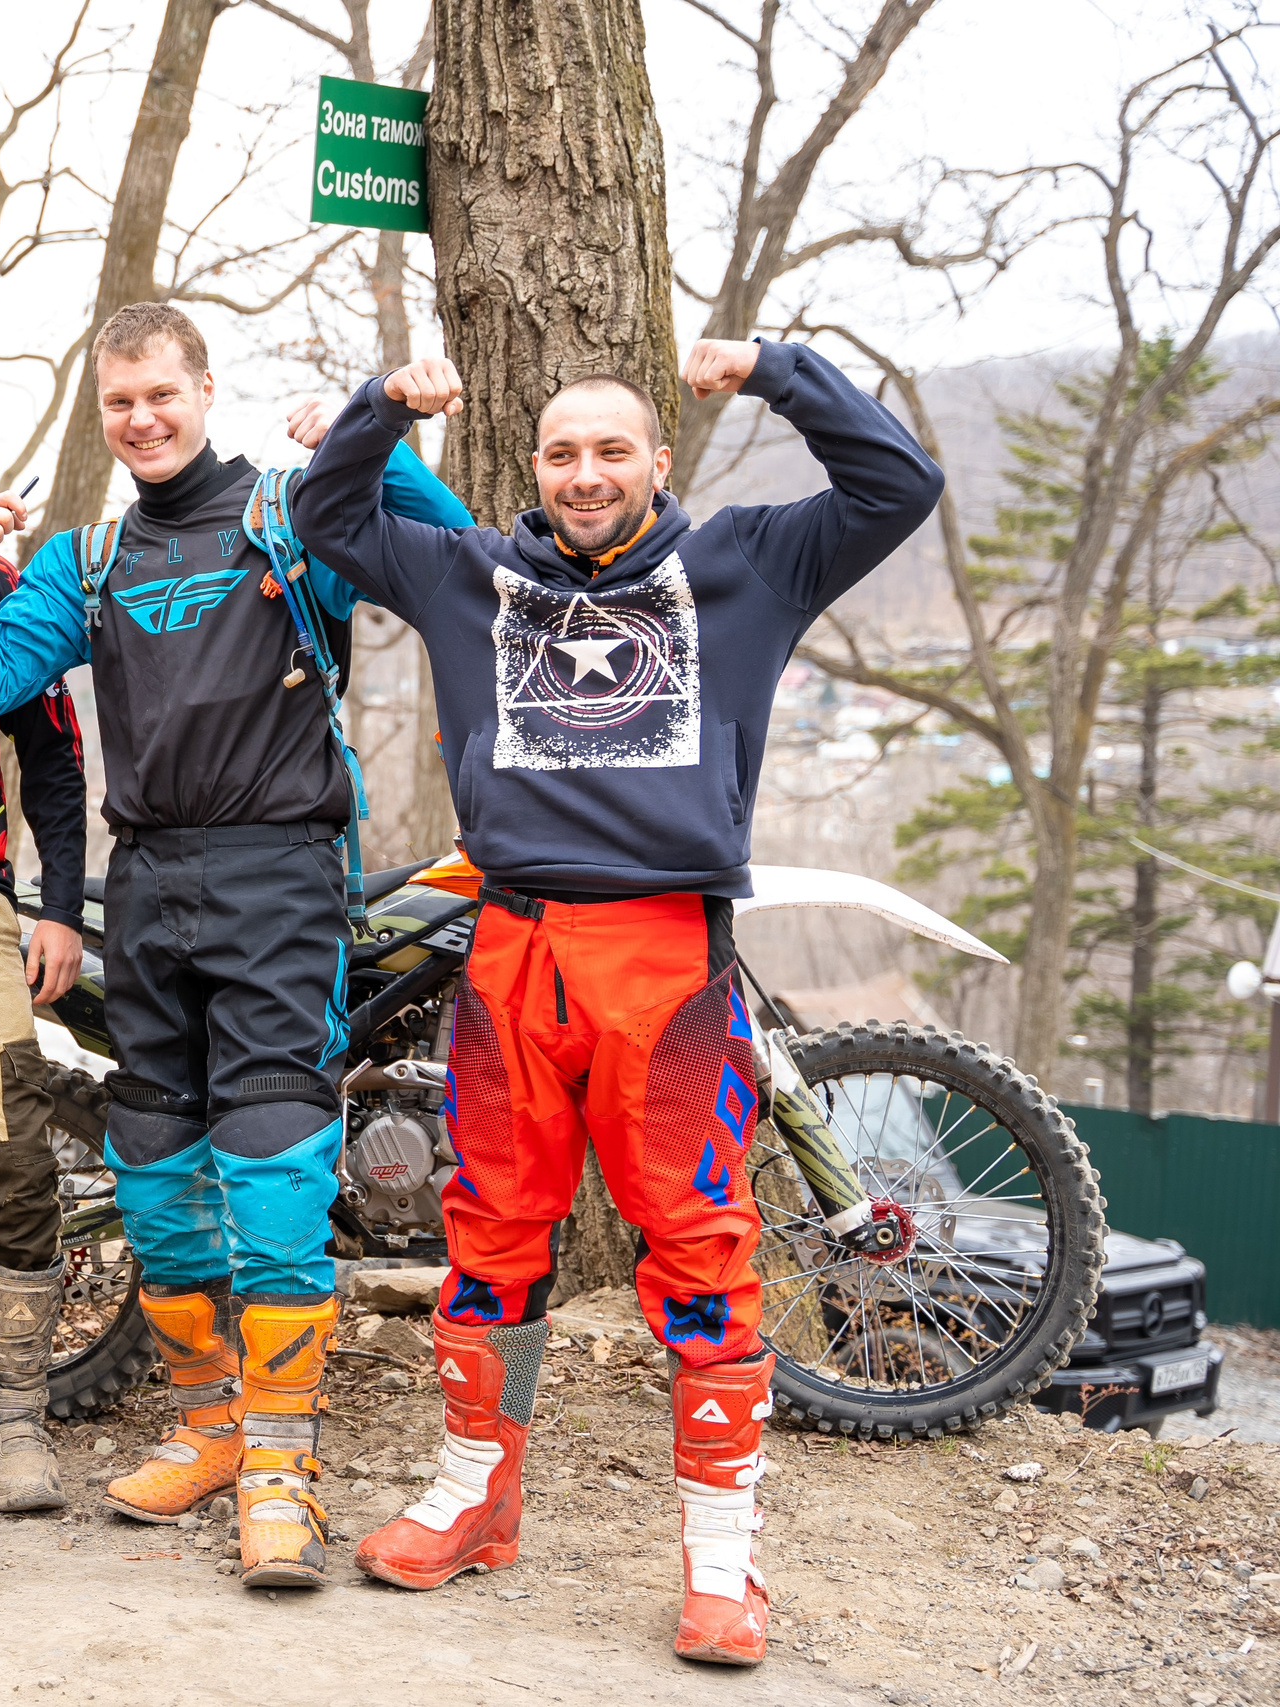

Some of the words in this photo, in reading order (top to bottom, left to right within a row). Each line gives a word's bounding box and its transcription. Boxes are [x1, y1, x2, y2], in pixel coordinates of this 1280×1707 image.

[319, 100, 367, 139] Зона
[370, 115, 426, 147] тамож
[316, 159, 420, 207] Customs
[62, 1234, 94, 1246] RUSSIA
